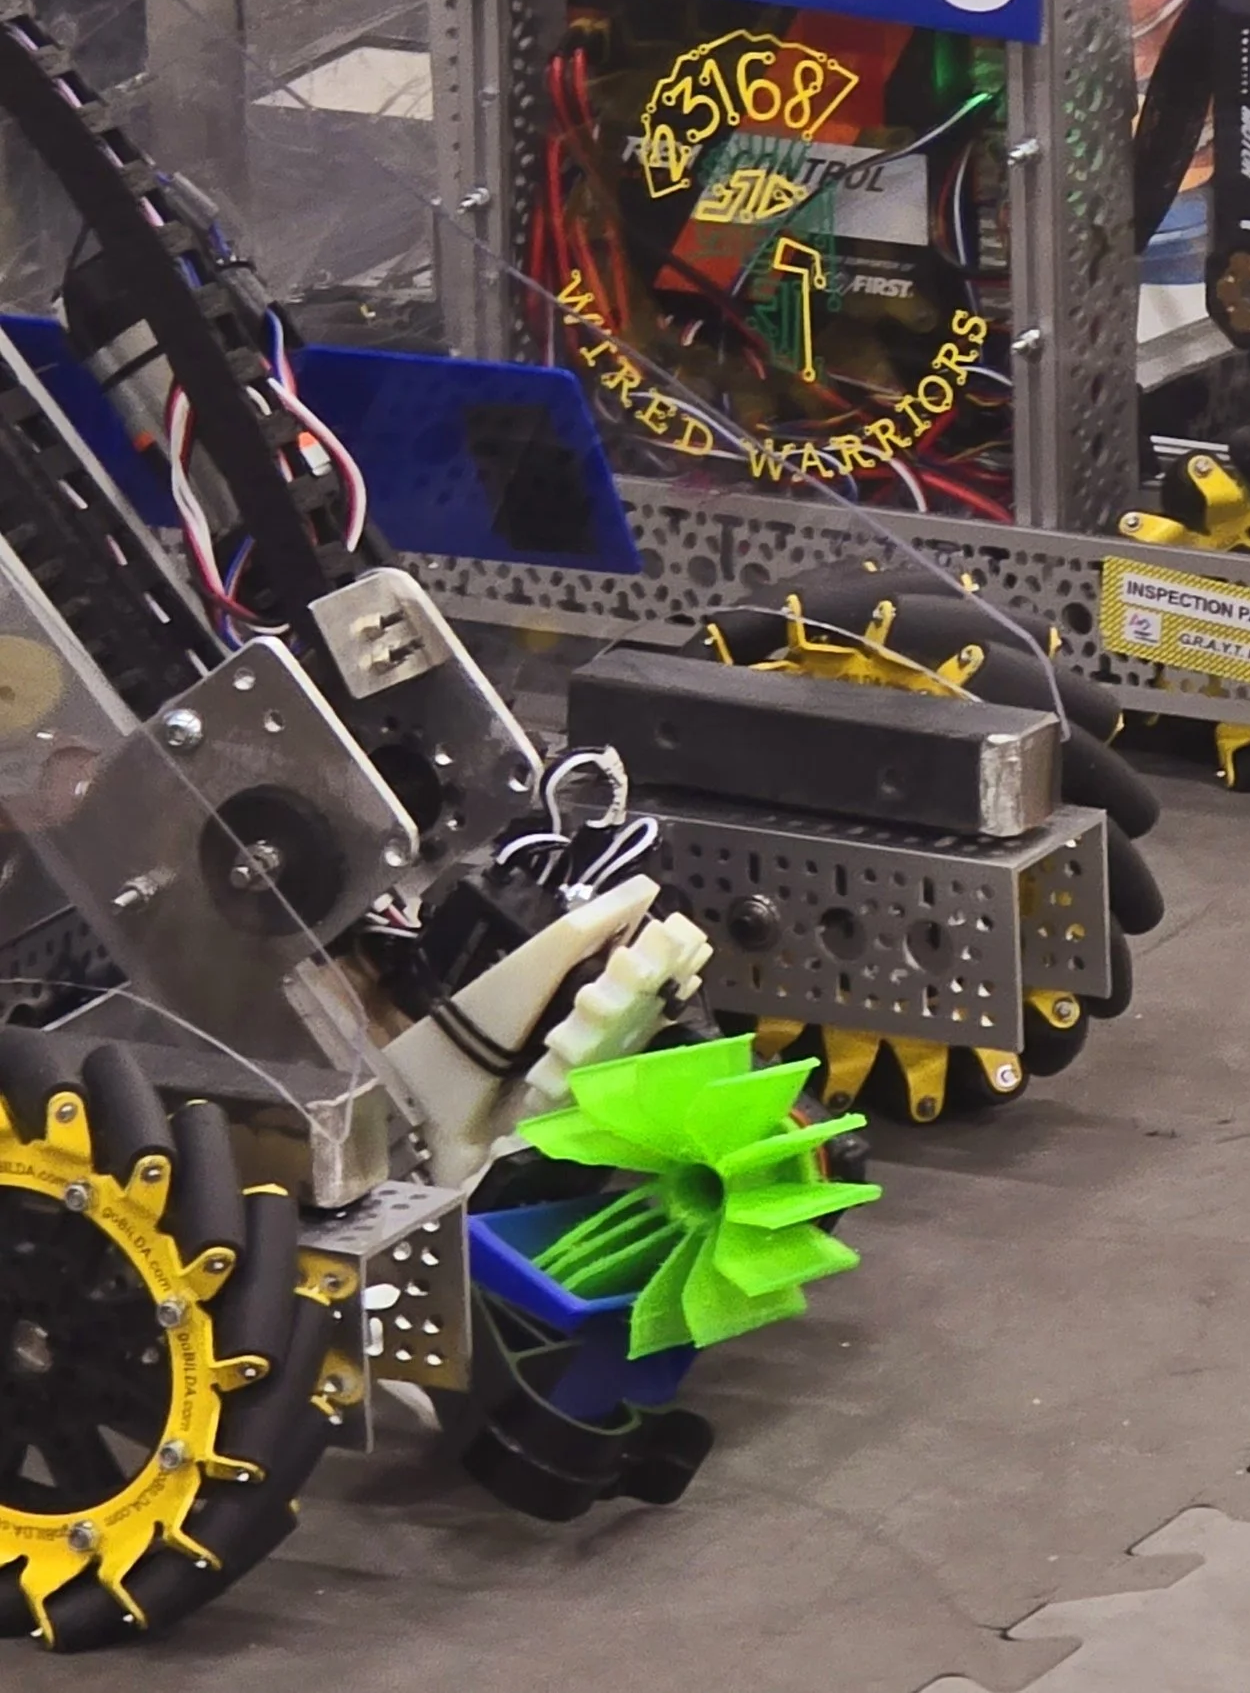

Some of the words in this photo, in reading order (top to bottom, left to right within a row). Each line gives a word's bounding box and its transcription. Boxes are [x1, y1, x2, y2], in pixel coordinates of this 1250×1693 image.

[852, 274, 914, 299] FIRST
[555, 269, 714, 457] WIRED
[740, 308, 988, 483] WARRIORS
[1126, 579, 1234, 619] INSPECTION
